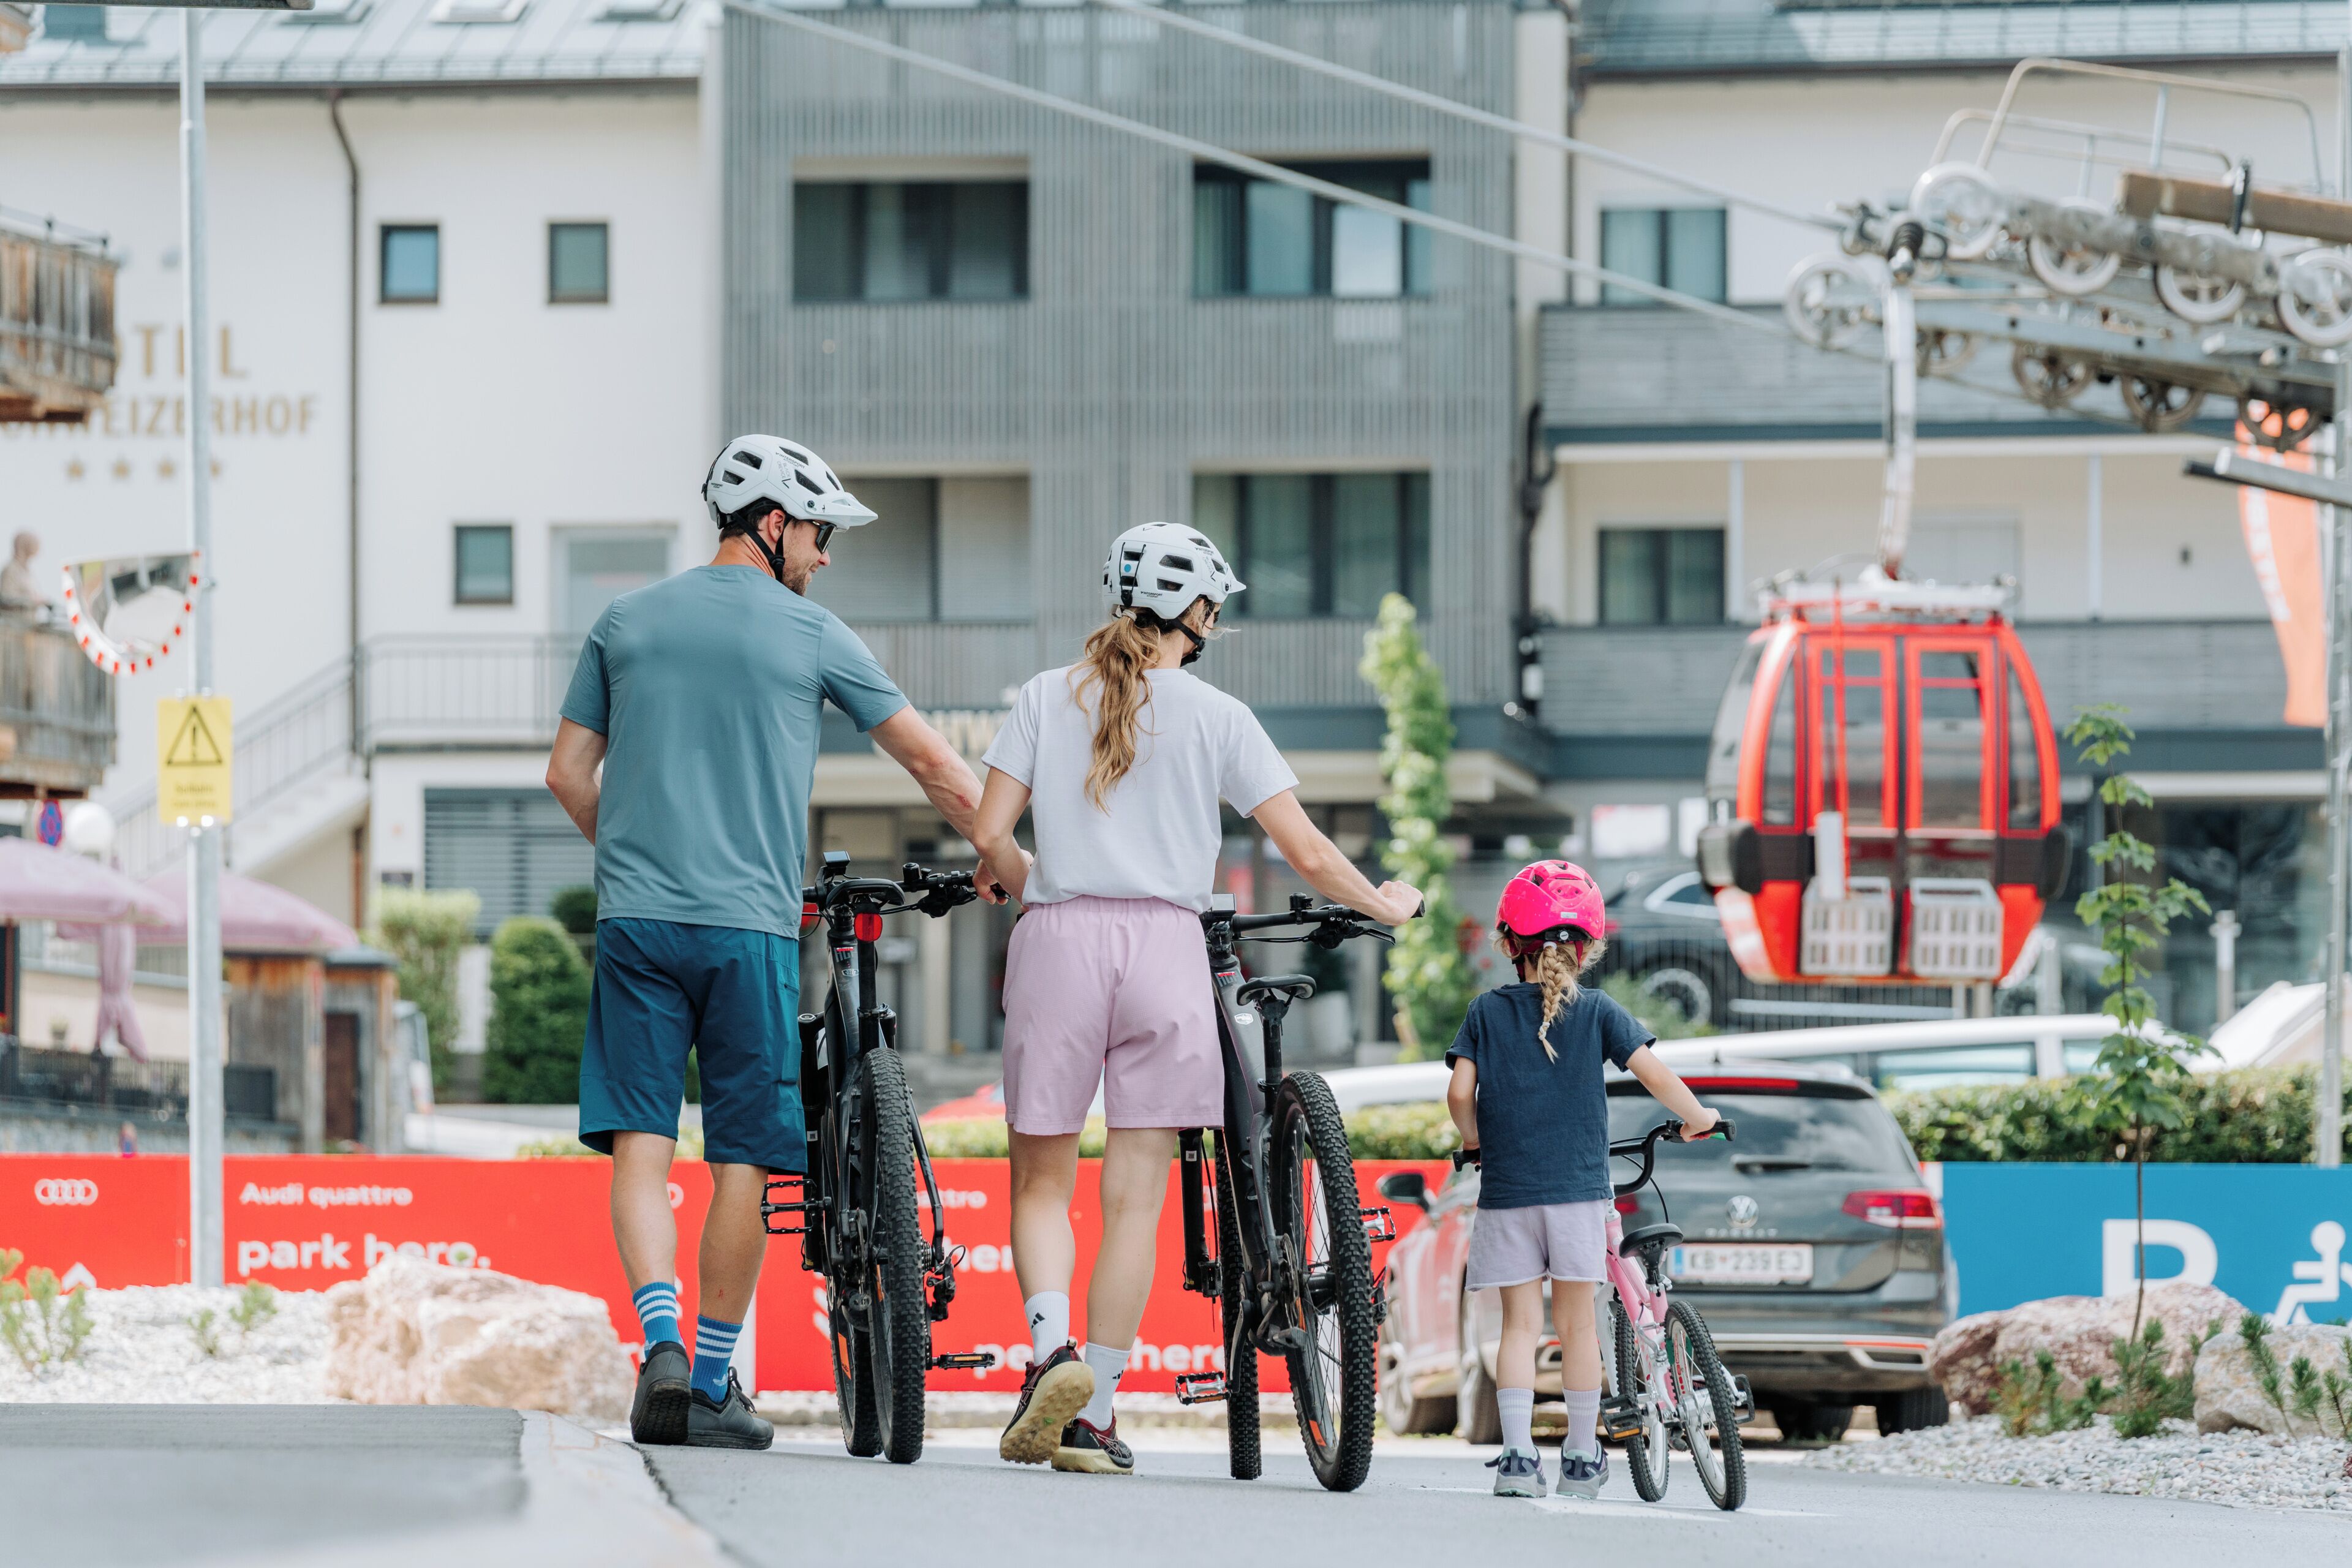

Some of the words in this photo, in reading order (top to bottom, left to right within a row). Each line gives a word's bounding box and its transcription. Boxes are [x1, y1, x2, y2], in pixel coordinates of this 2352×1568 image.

[779, 453, 805, 469] INTERSPORT
[239, 1182, 304, 1205] Audi
[308, 1185, 413, 1209] quattro
[238, 1232, 351, 1277] park
